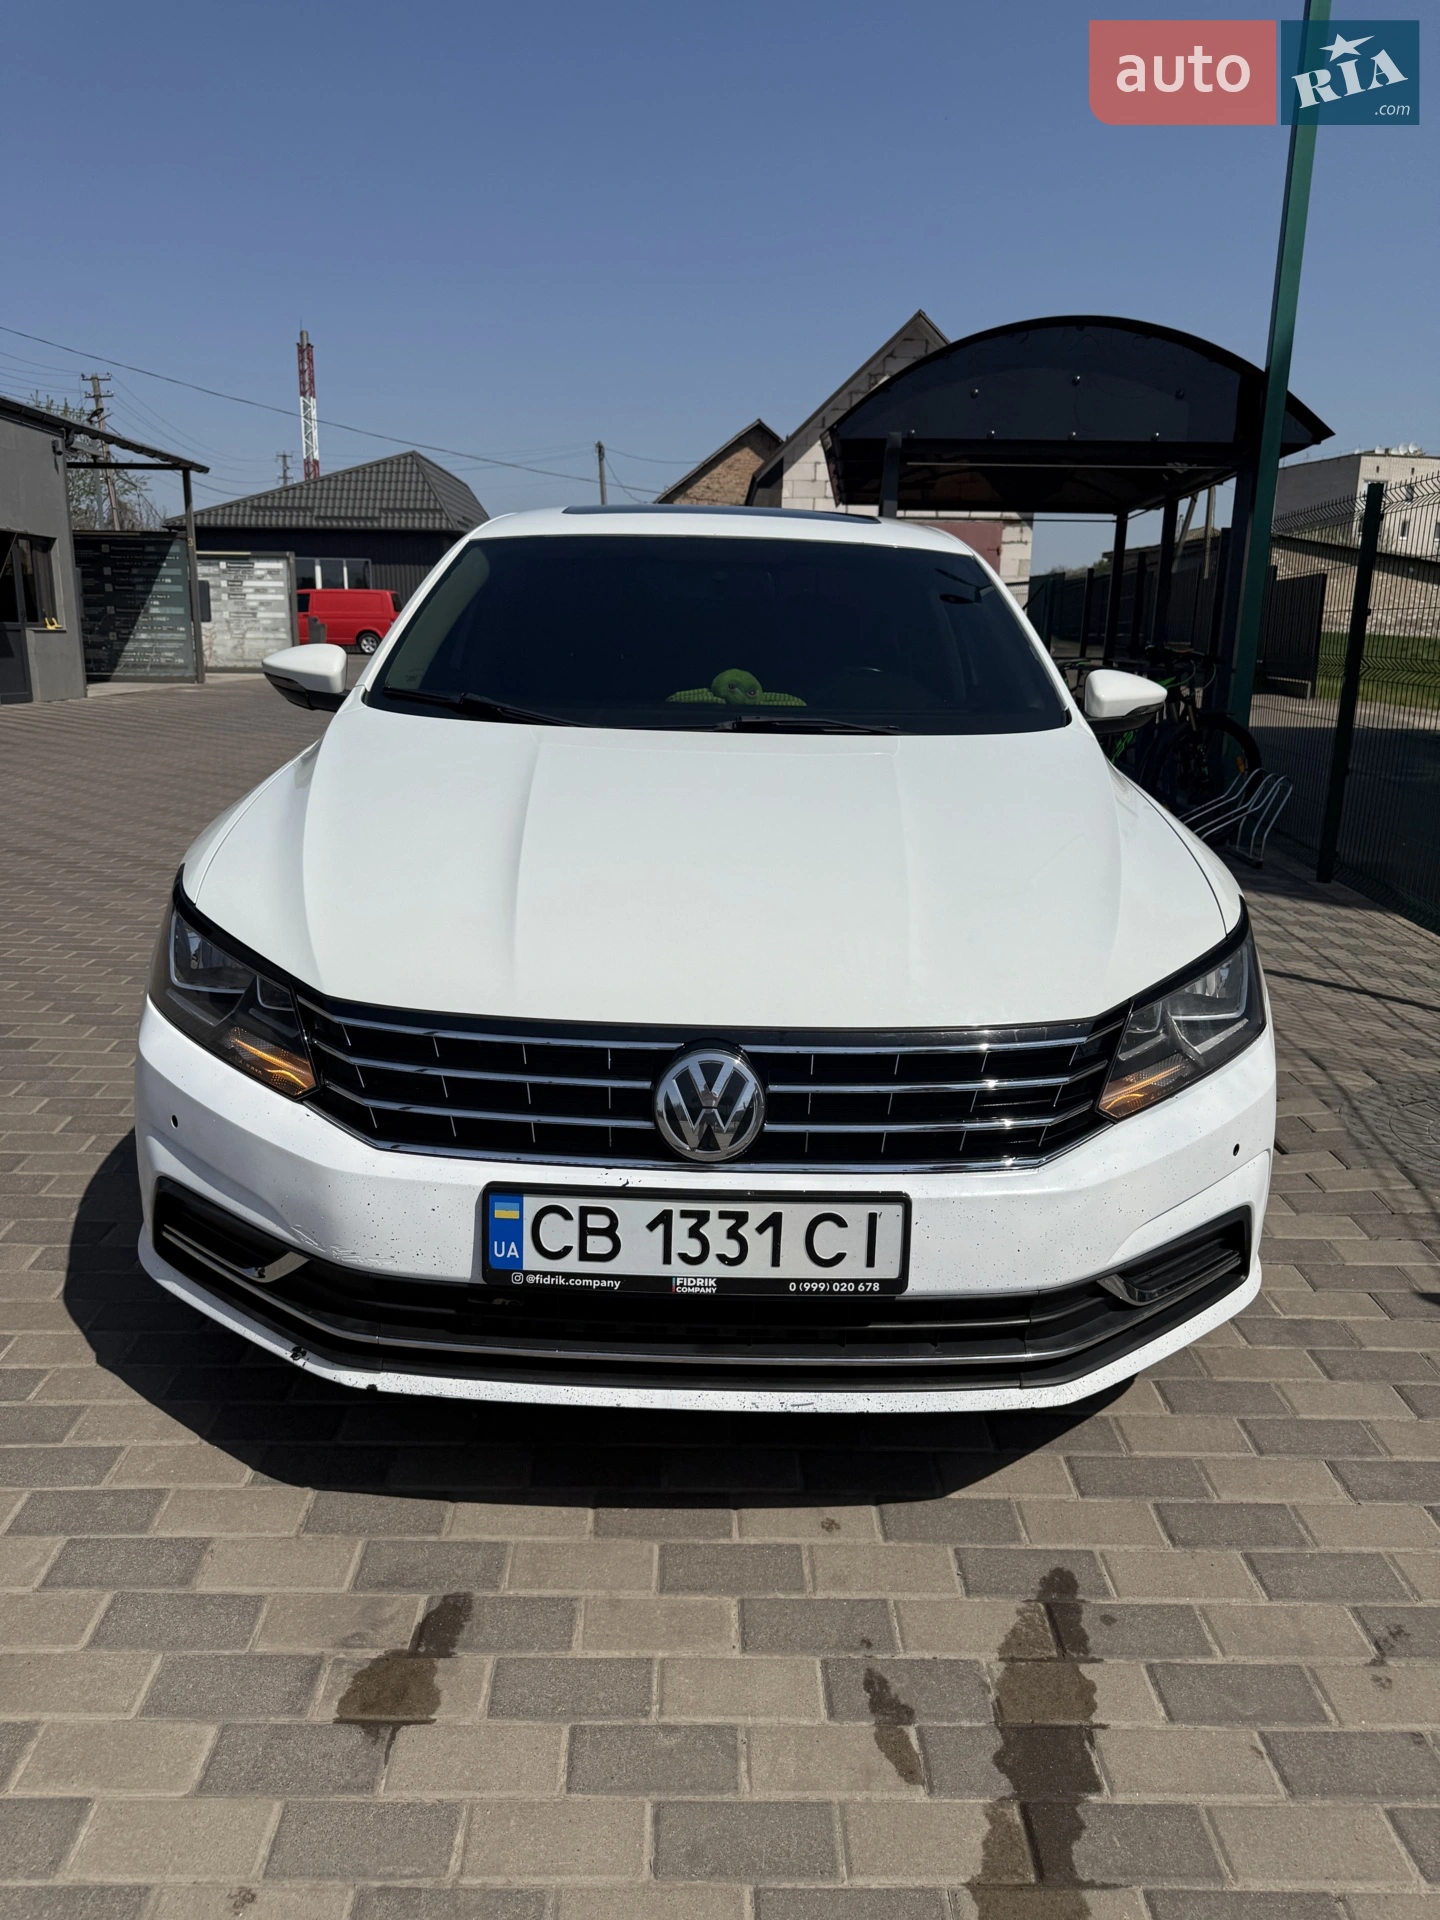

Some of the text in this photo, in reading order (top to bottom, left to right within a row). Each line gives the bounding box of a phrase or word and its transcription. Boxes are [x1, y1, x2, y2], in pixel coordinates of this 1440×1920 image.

[530, 1204, 879, 1269] CB 1331 CI
[493, 1240, 520, 1259] UA
[526, 1273, 621, 1290] @fidrik.company
[676, 1277, 717, 1287] FIDRIK
[788, 1282, 880, 1292] 0 (999) 020 678
[676, 1286, 717, 1294] COMPANY
